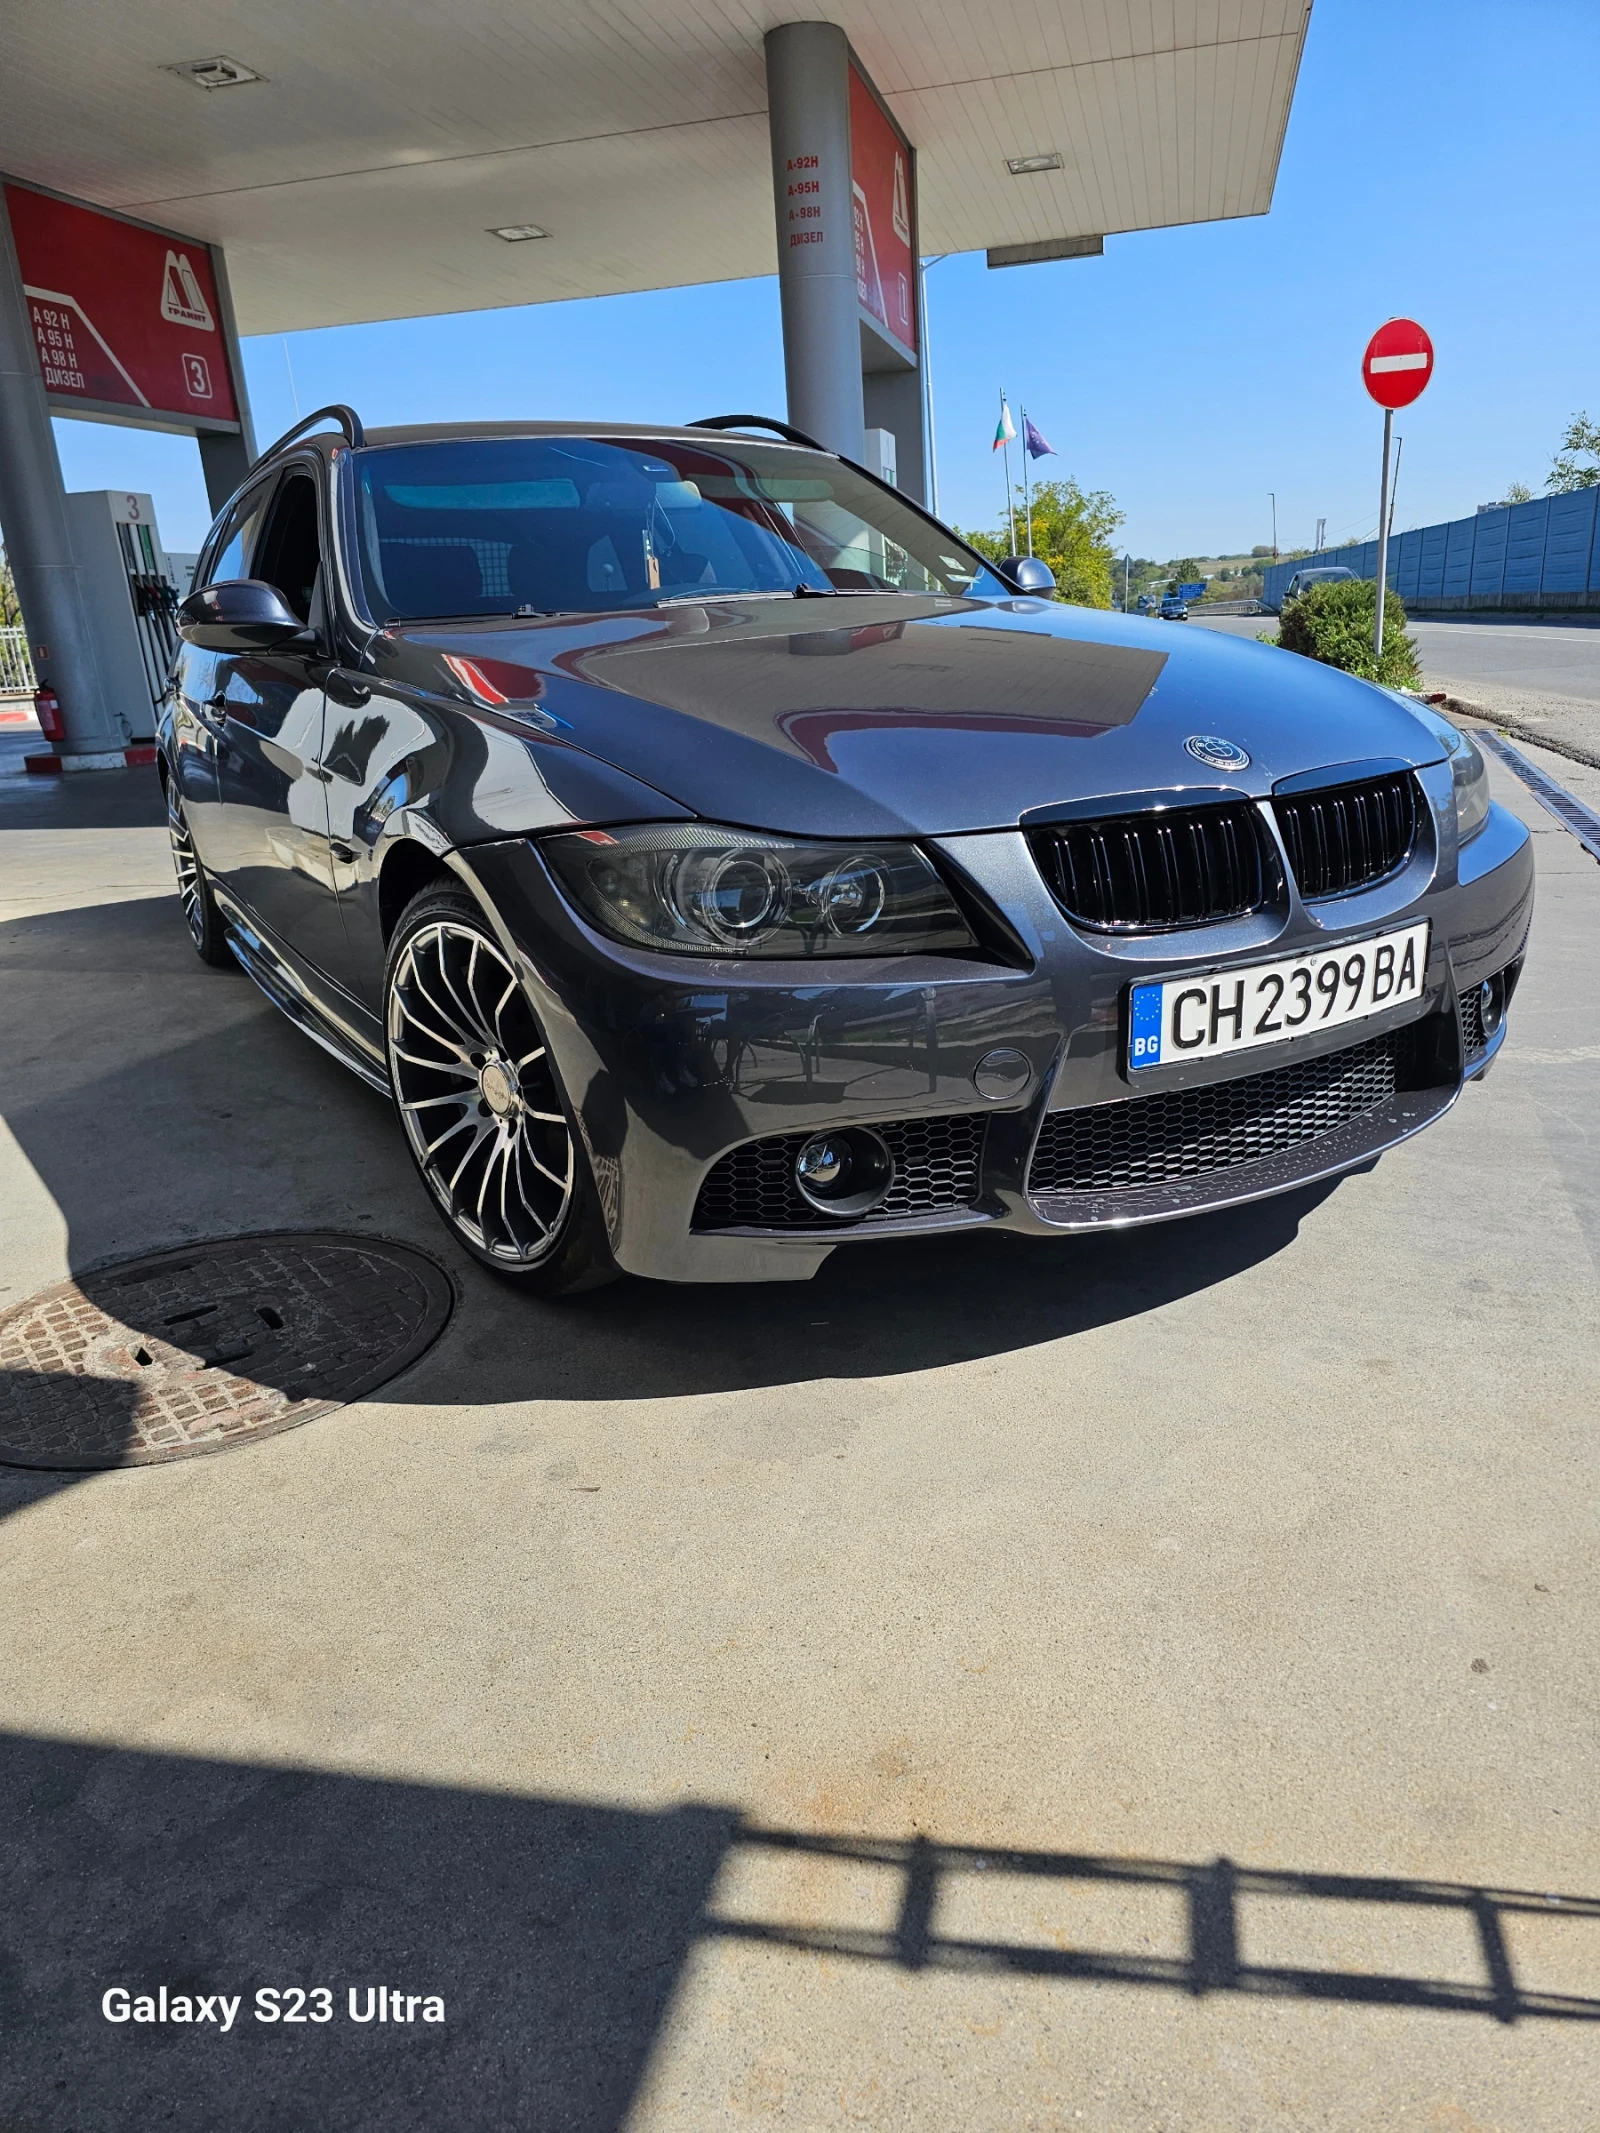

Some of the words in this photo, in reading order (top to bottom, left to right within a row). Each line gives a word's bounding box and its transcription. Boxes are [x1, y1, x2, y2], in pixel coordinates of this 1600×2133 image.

[790, 231, 823, 248] ДИЗЕЛ
[43, 309, 59, 327] 92
[47, 329, 63, 347] 95
[51, 349, 67, 367] 98
[45, 367, 85, 388] ДИЗЕЛ
[191, 361, 205, 393] 3
[127, 495, 140, 520] 3
[1134, 1035, 1159, 1056] BG
